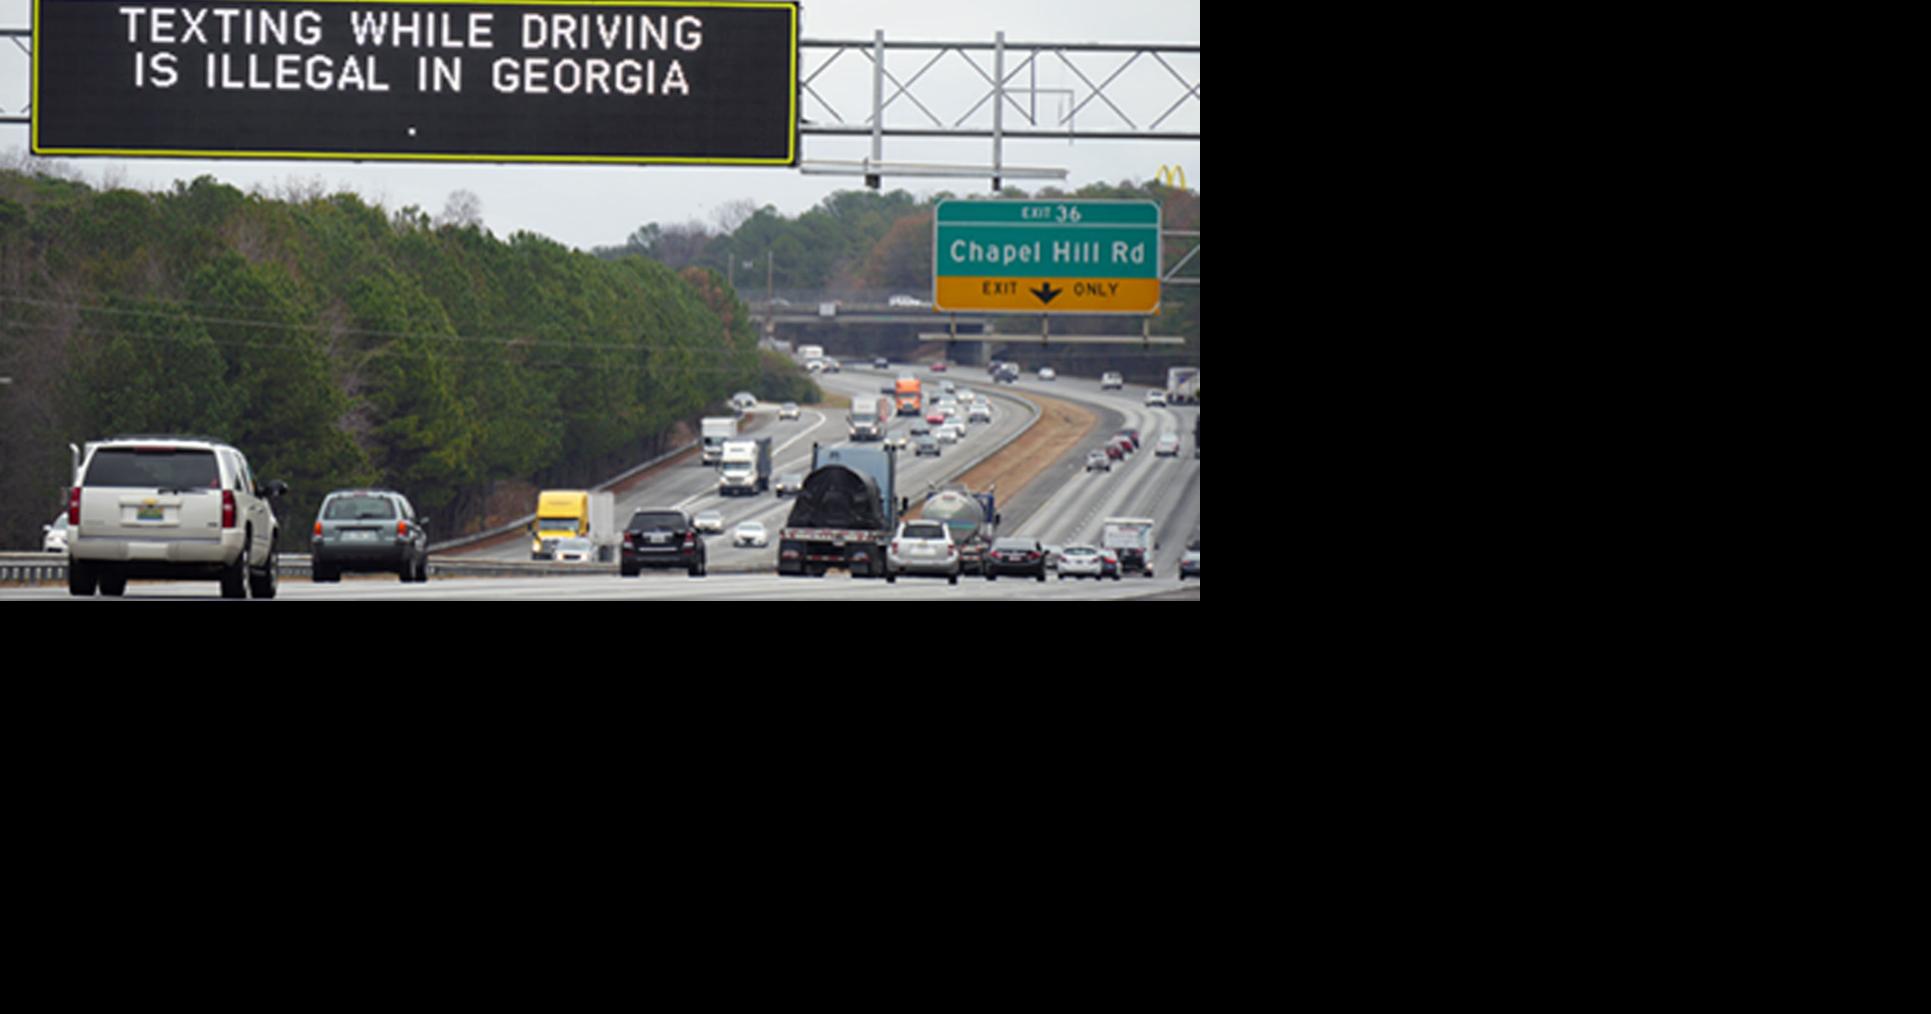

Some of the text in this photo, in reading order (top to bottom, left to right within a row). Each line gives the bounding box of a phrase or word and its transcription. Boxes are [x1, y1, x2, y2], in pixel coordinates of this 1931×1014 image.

[119, 7, 703, 52] TEXTING WHILE DRIVING
[135, 53, 690, 96] IS ILLEGAL IN GEORGIA
[1021, 205, 1082, 223] EXIT 36
[949, 239, 1145, 266] Chapel Hill Rd
[981, 281, 1119, 298] EXIT ONLY
